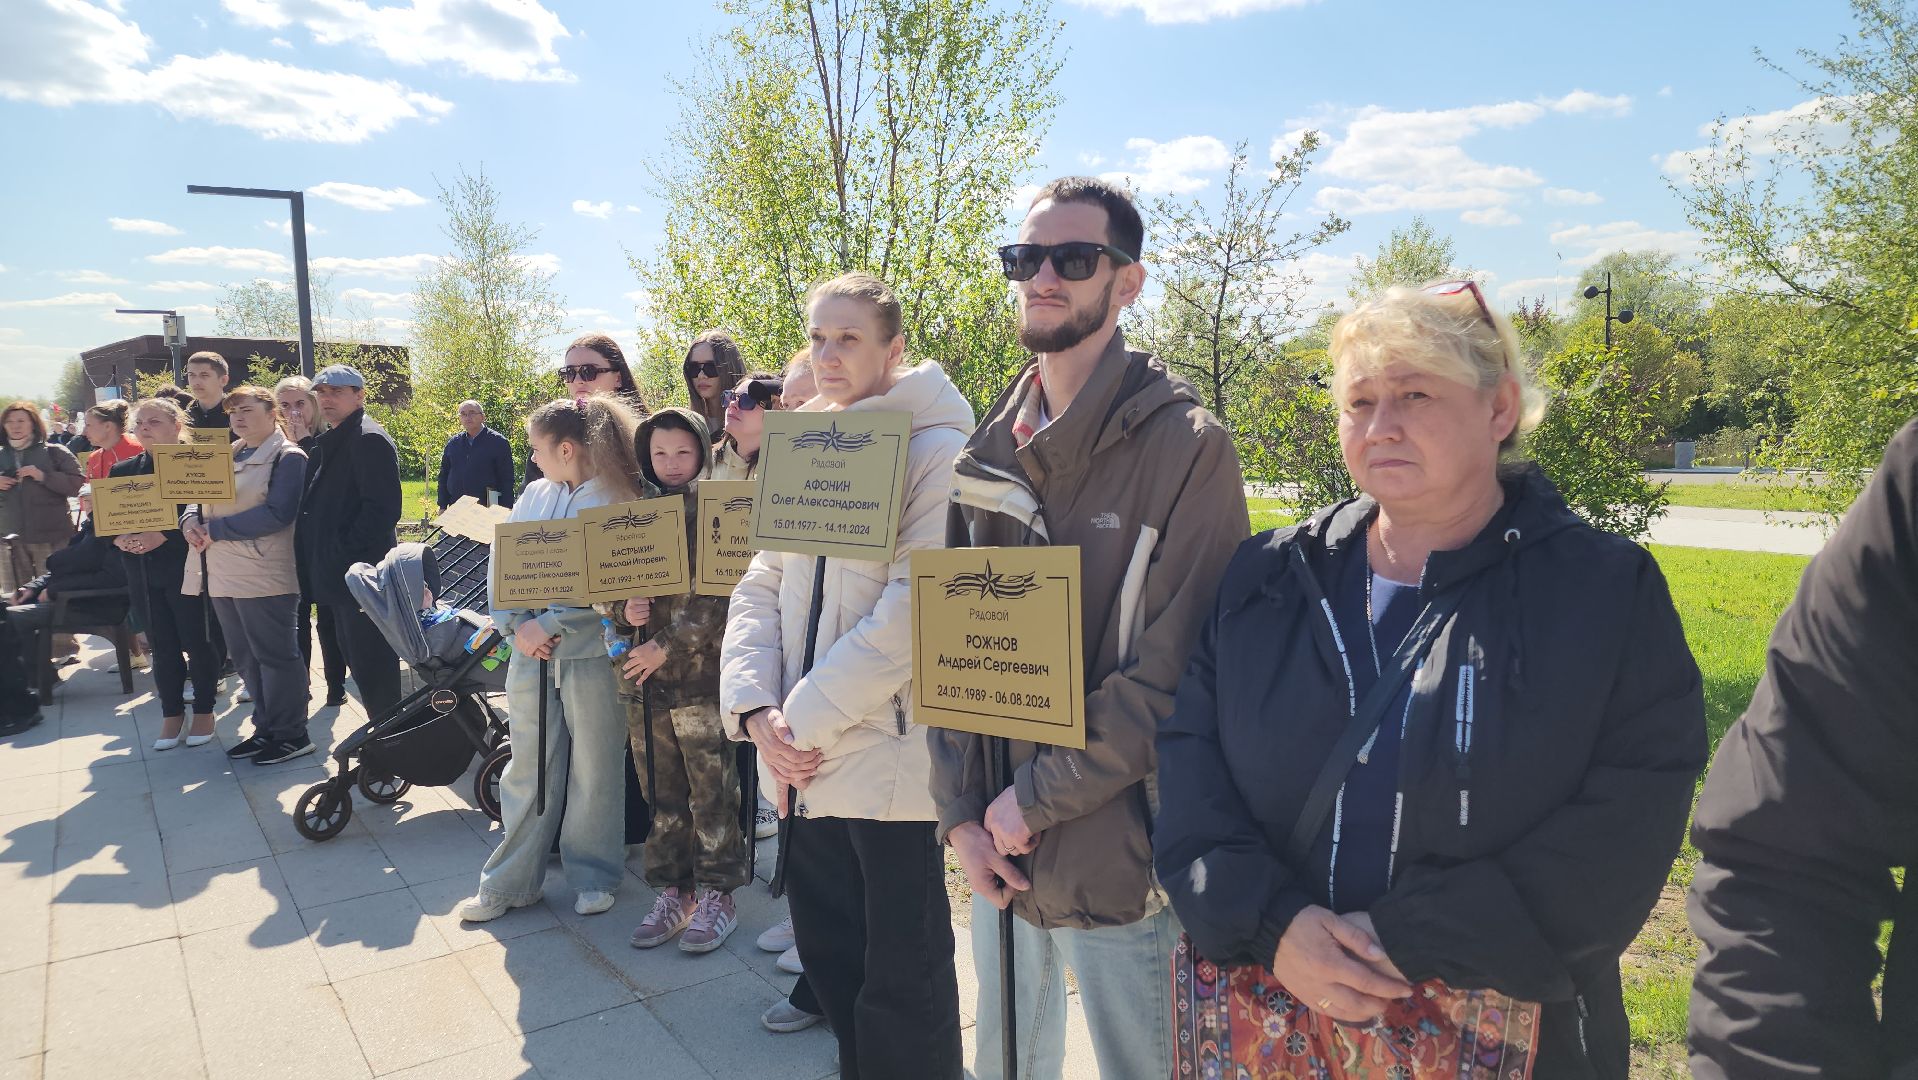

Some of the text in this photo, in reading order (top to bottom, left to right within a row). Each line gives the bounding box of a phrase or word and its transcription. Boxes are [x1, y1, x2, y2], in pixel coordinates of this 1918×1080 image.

[811, 457, 846, 469] Рядовой
[804, 479, 851, 492] АФОНИН
[771, 493, 880, 511] Олег Александрович
[773, 519, 817, 531] 15.01.1977
[825, 522, 870, 535] 14.11.2024
[611, 544, 655, 557] БАСТРЫКИН
[716, 548, 752, 558] Алексей
[522, 560, 563, 570] ПИЛИПЕНКО
[599, 556, 668, 569] Николай Игоревич
[504, 573, 538, 581] Владимир
[969, 608, 1009, 621] Рядовой
[966, 634, 1018, 651] РОЖНОВ
[937, 653, 1049, 676] Андрей Сергеевич
[937, 684, 987, 701] 24.07.1989
[995, 691, 1051, 709] 06.08.2024
